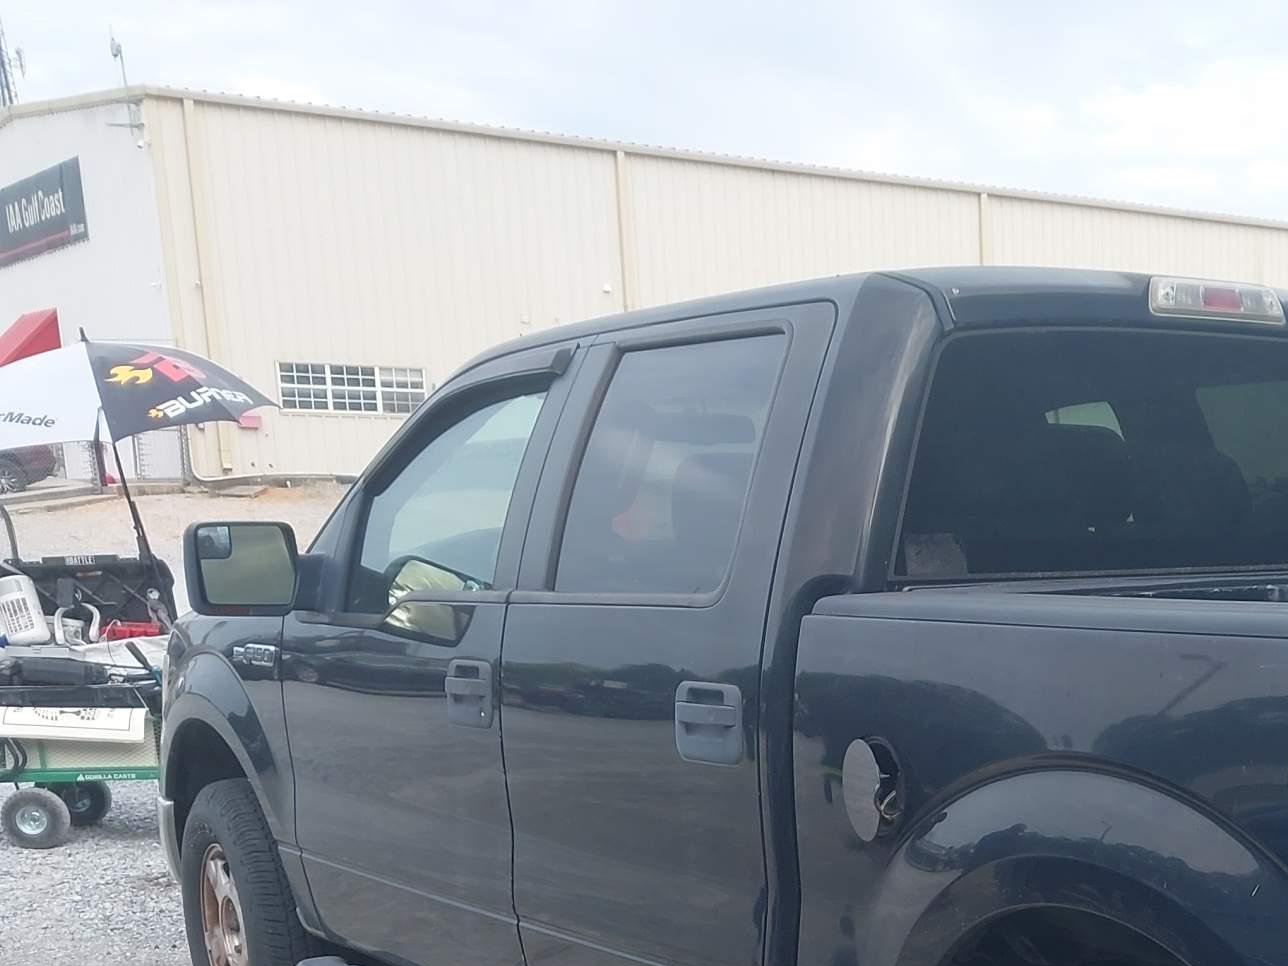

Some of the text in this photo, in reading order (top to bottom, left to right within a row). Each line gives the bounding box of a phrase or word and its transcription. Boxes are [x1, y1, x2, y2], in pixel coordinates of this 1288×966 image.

[5, 187, 66, 233] IAA Gulf Coast
[155, 386, 254, 418] BURNER
